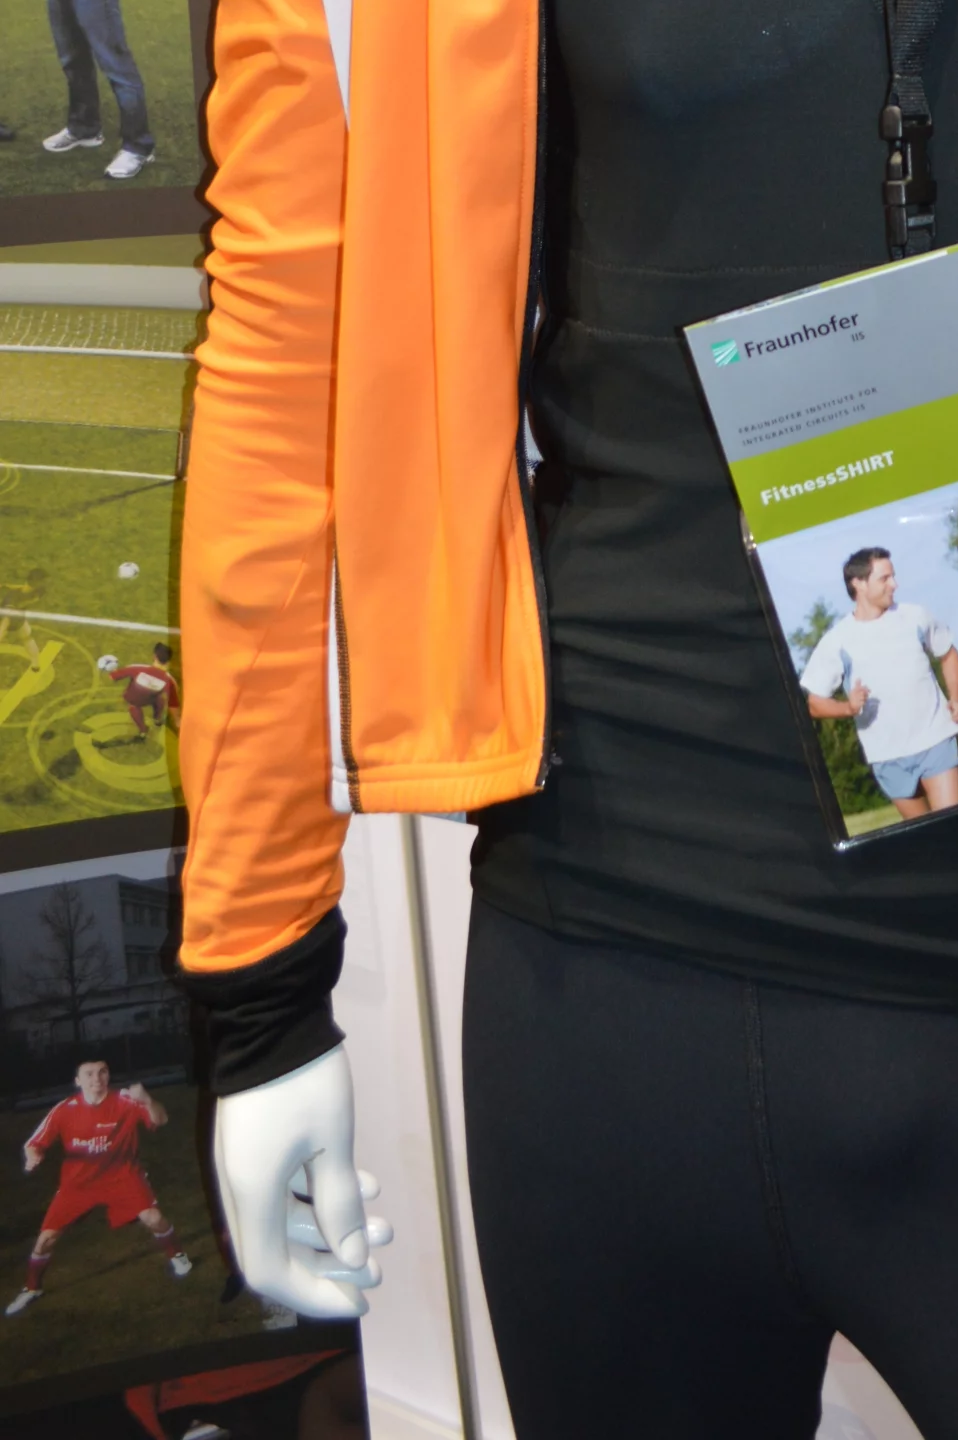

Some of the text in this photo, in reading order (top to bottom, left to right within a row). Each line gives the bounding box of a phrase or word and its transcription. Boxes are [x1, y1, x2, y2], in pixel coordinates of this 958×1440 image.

[743, 313, 859, 359] Fraunhofer
[851, 331, 866, 343] IIS
[738, 387, 879, 436] FRAUNHOFER INSTITUTE FOR
[741, 425, 803, 447] INTEGRATED
[805, 408, 850, 429] CIRCUITS
[759, 450, 895, 506] FitnessSHIRT
